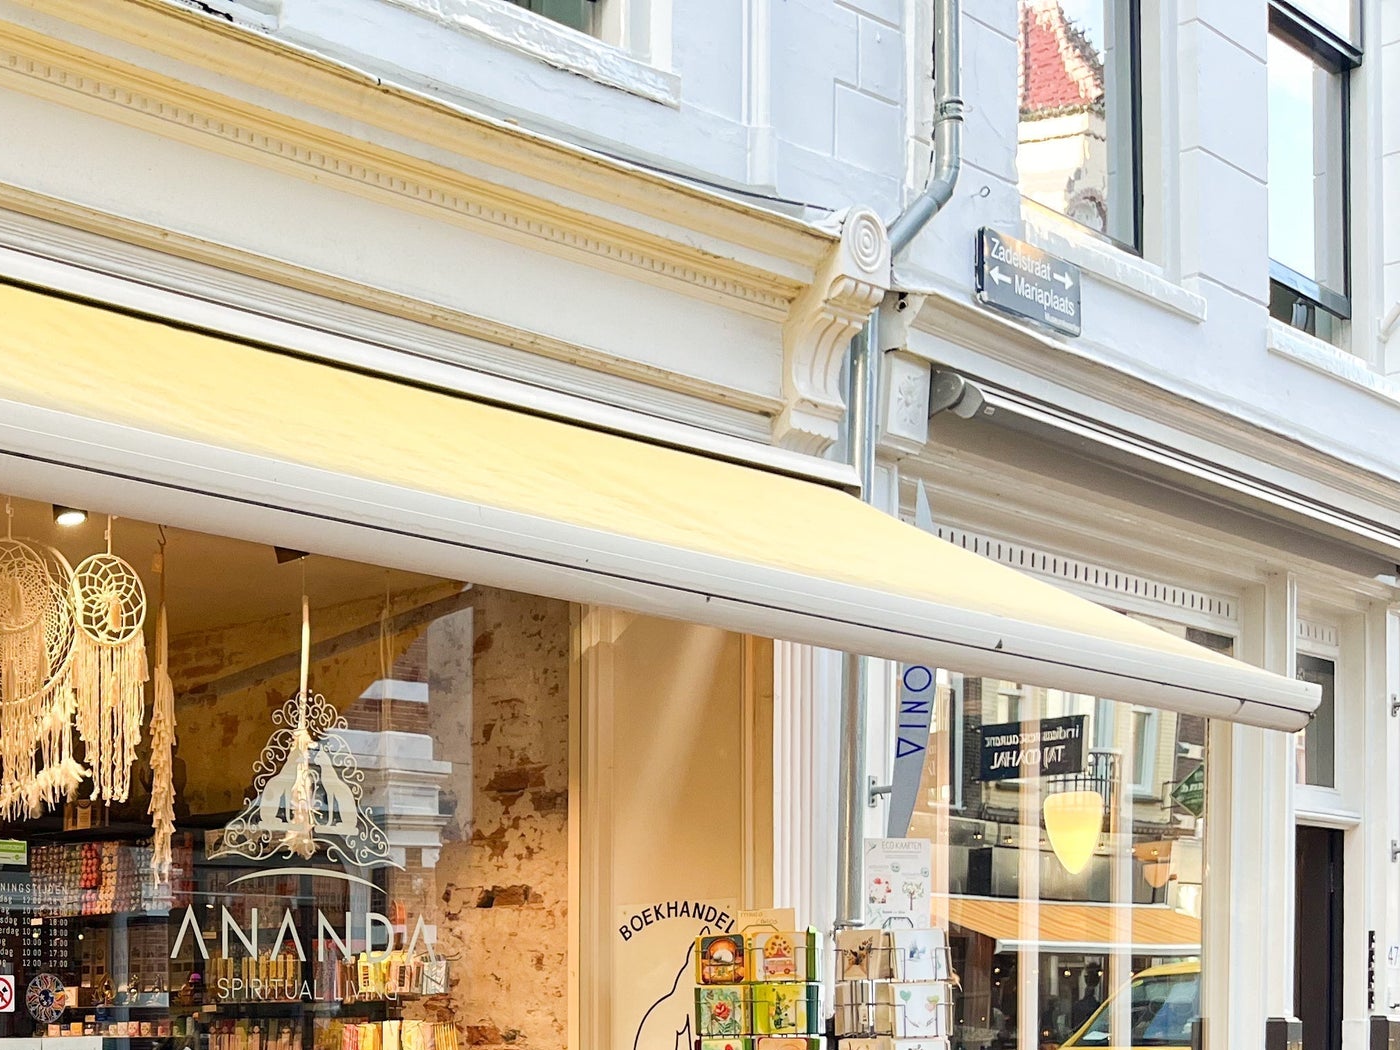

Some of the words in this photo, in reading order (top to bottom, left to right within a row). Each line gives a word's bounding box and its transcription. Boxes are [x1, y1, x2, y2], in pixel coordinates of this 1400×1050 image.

[991, 237, 1051, 281] Zadelstraat
[1014, 274, 1075, 316] Mariaplaats
[170, 903, 437, 965] ANANDA
[1387, 945, 1399, 966] 47
[217, 978, 323, 1000] SPIRITUAL
[334, 979, 398, 1001] LIVING
